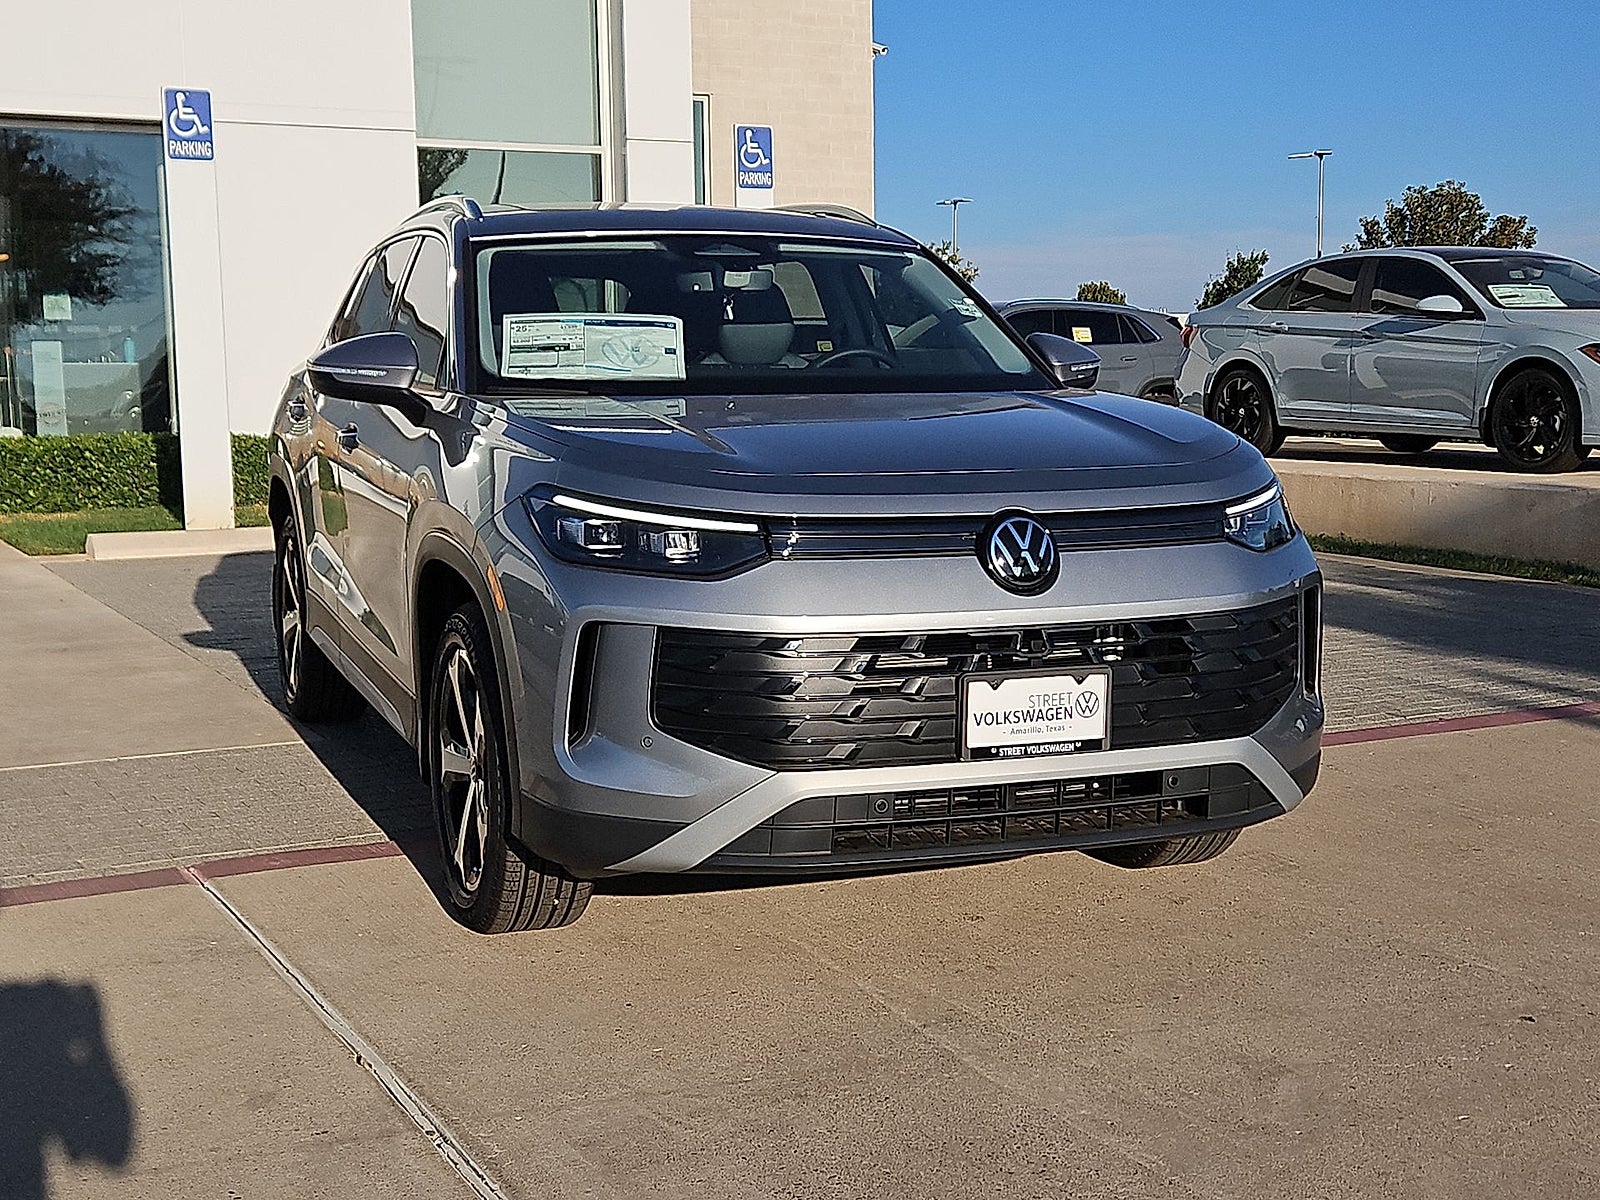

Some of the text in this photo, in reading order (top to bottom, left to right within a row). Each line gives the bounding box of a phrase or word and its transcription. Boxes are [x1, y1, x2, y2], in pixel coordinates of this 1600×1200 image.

[169, 140, 212, 157] PARKING
[740, 171, 771, 185] PARKING
[1028, 692, 1073, 709] STREET
[973, 706, 1073, 726] VOLKSWAGEN
[1010, 725, 1065, 735] Amarillo, Texas
[999, 742, 1075, 757] STREET VOLKSWAGEN
